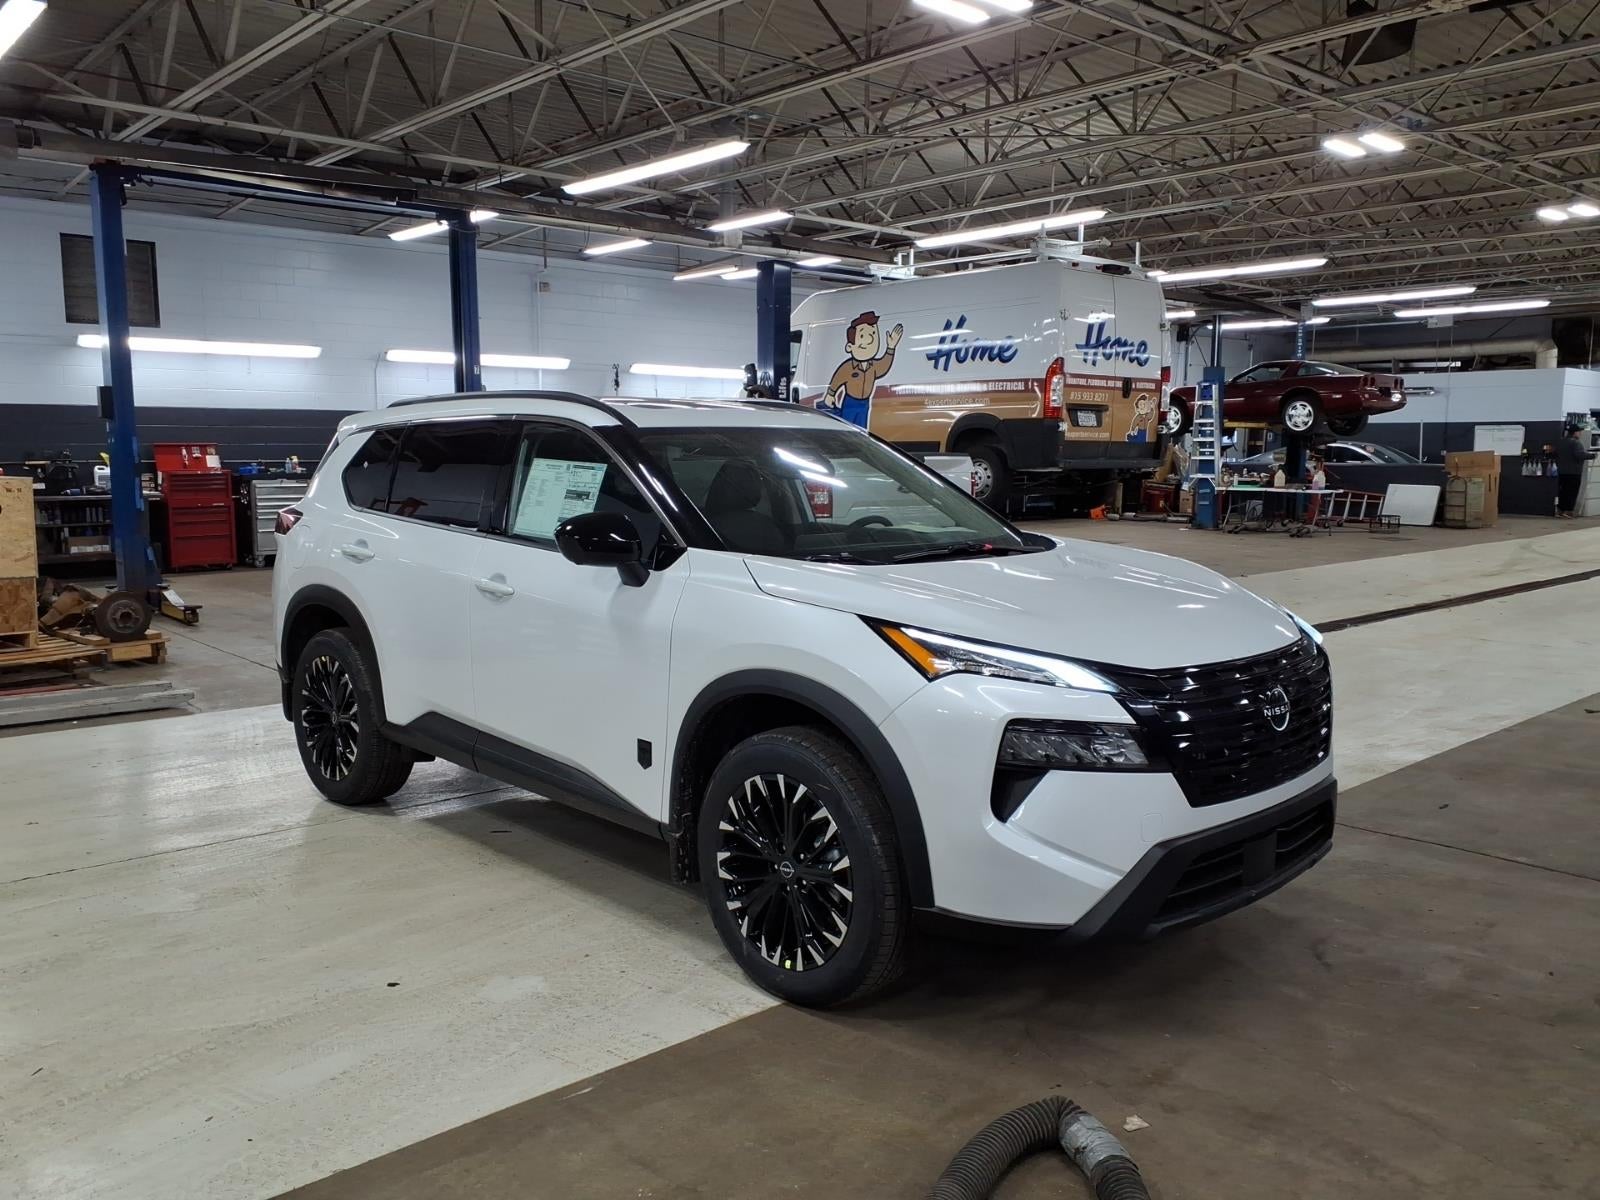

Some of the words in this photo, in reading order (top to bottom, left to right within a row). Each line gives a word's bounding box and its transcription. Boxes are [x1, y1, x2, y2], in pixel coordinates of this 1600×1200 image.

[926, 314, 1018, 372] Home
[1075, 319, 1150, 367] Home
[989, 381, 1025, 391] ELECTRICAL
